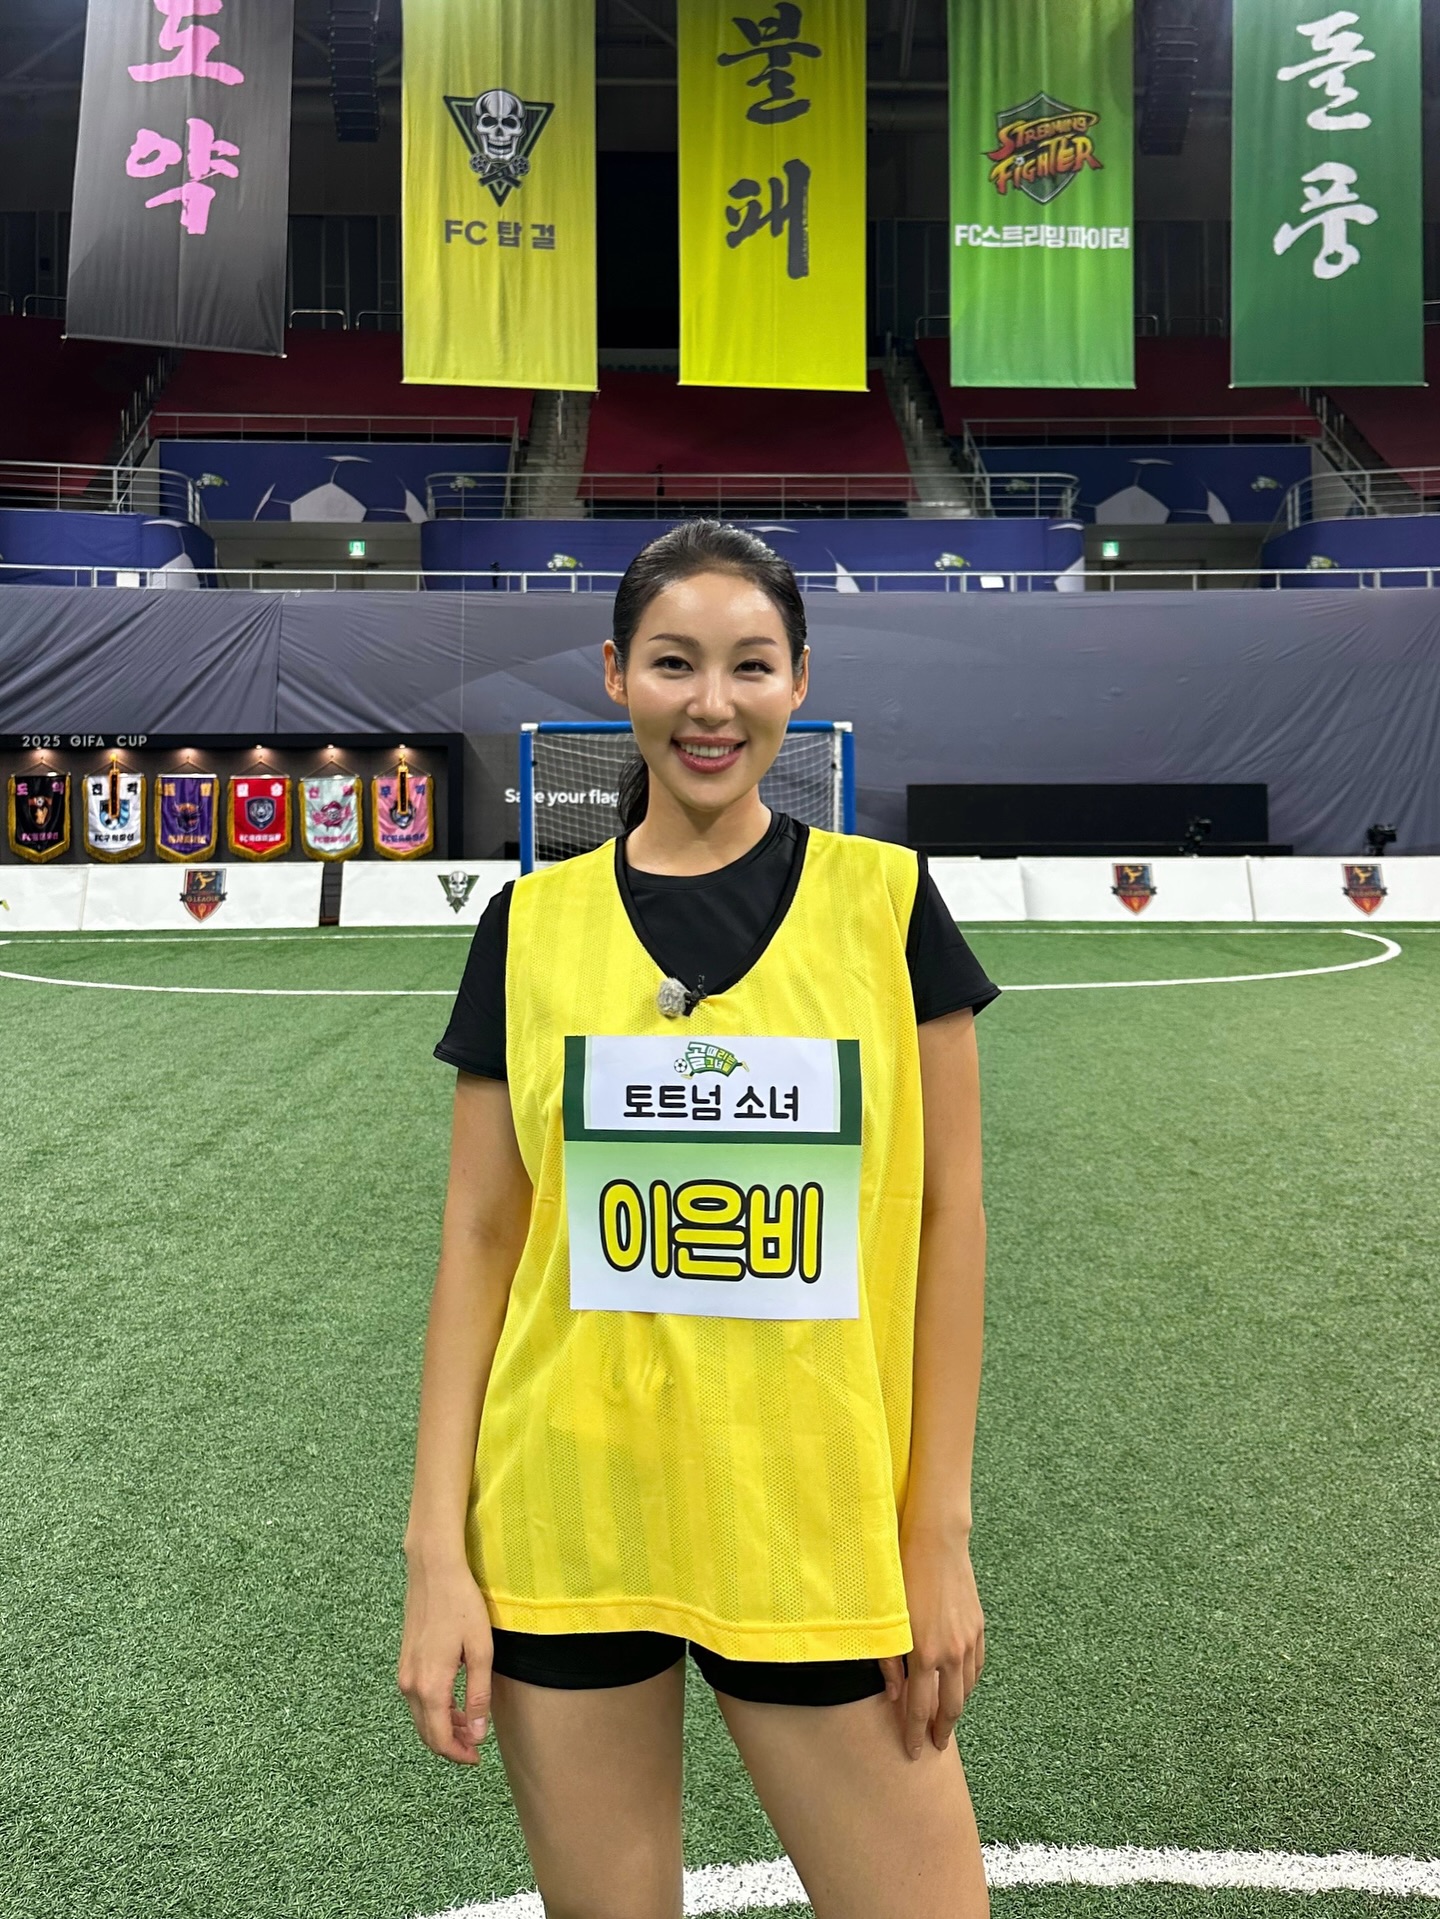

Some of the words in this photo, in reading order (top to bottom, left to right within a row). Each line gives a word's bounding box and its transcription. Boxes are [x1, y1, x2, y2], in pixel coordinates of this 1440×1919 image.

[717, 2, 822, 280] 불패
[990, 134, 1103, 194] FIGHTER
[1273, 11, 1379, 279] 돌풍
[445, 220, 488, 245] FC
[22, 735, 61, 747] 2025
[70, 735, 105, 747] GIFA
[116, 735, 148, 747] CUP
[504, 788, 545, 804] Se
[547, 790, 587, 807] your
[623, 1084, 722, 1121] 토트넘
[733, 1084, 799, 1122] 소녀
[598, 1178, 824, 1284] 이은비
